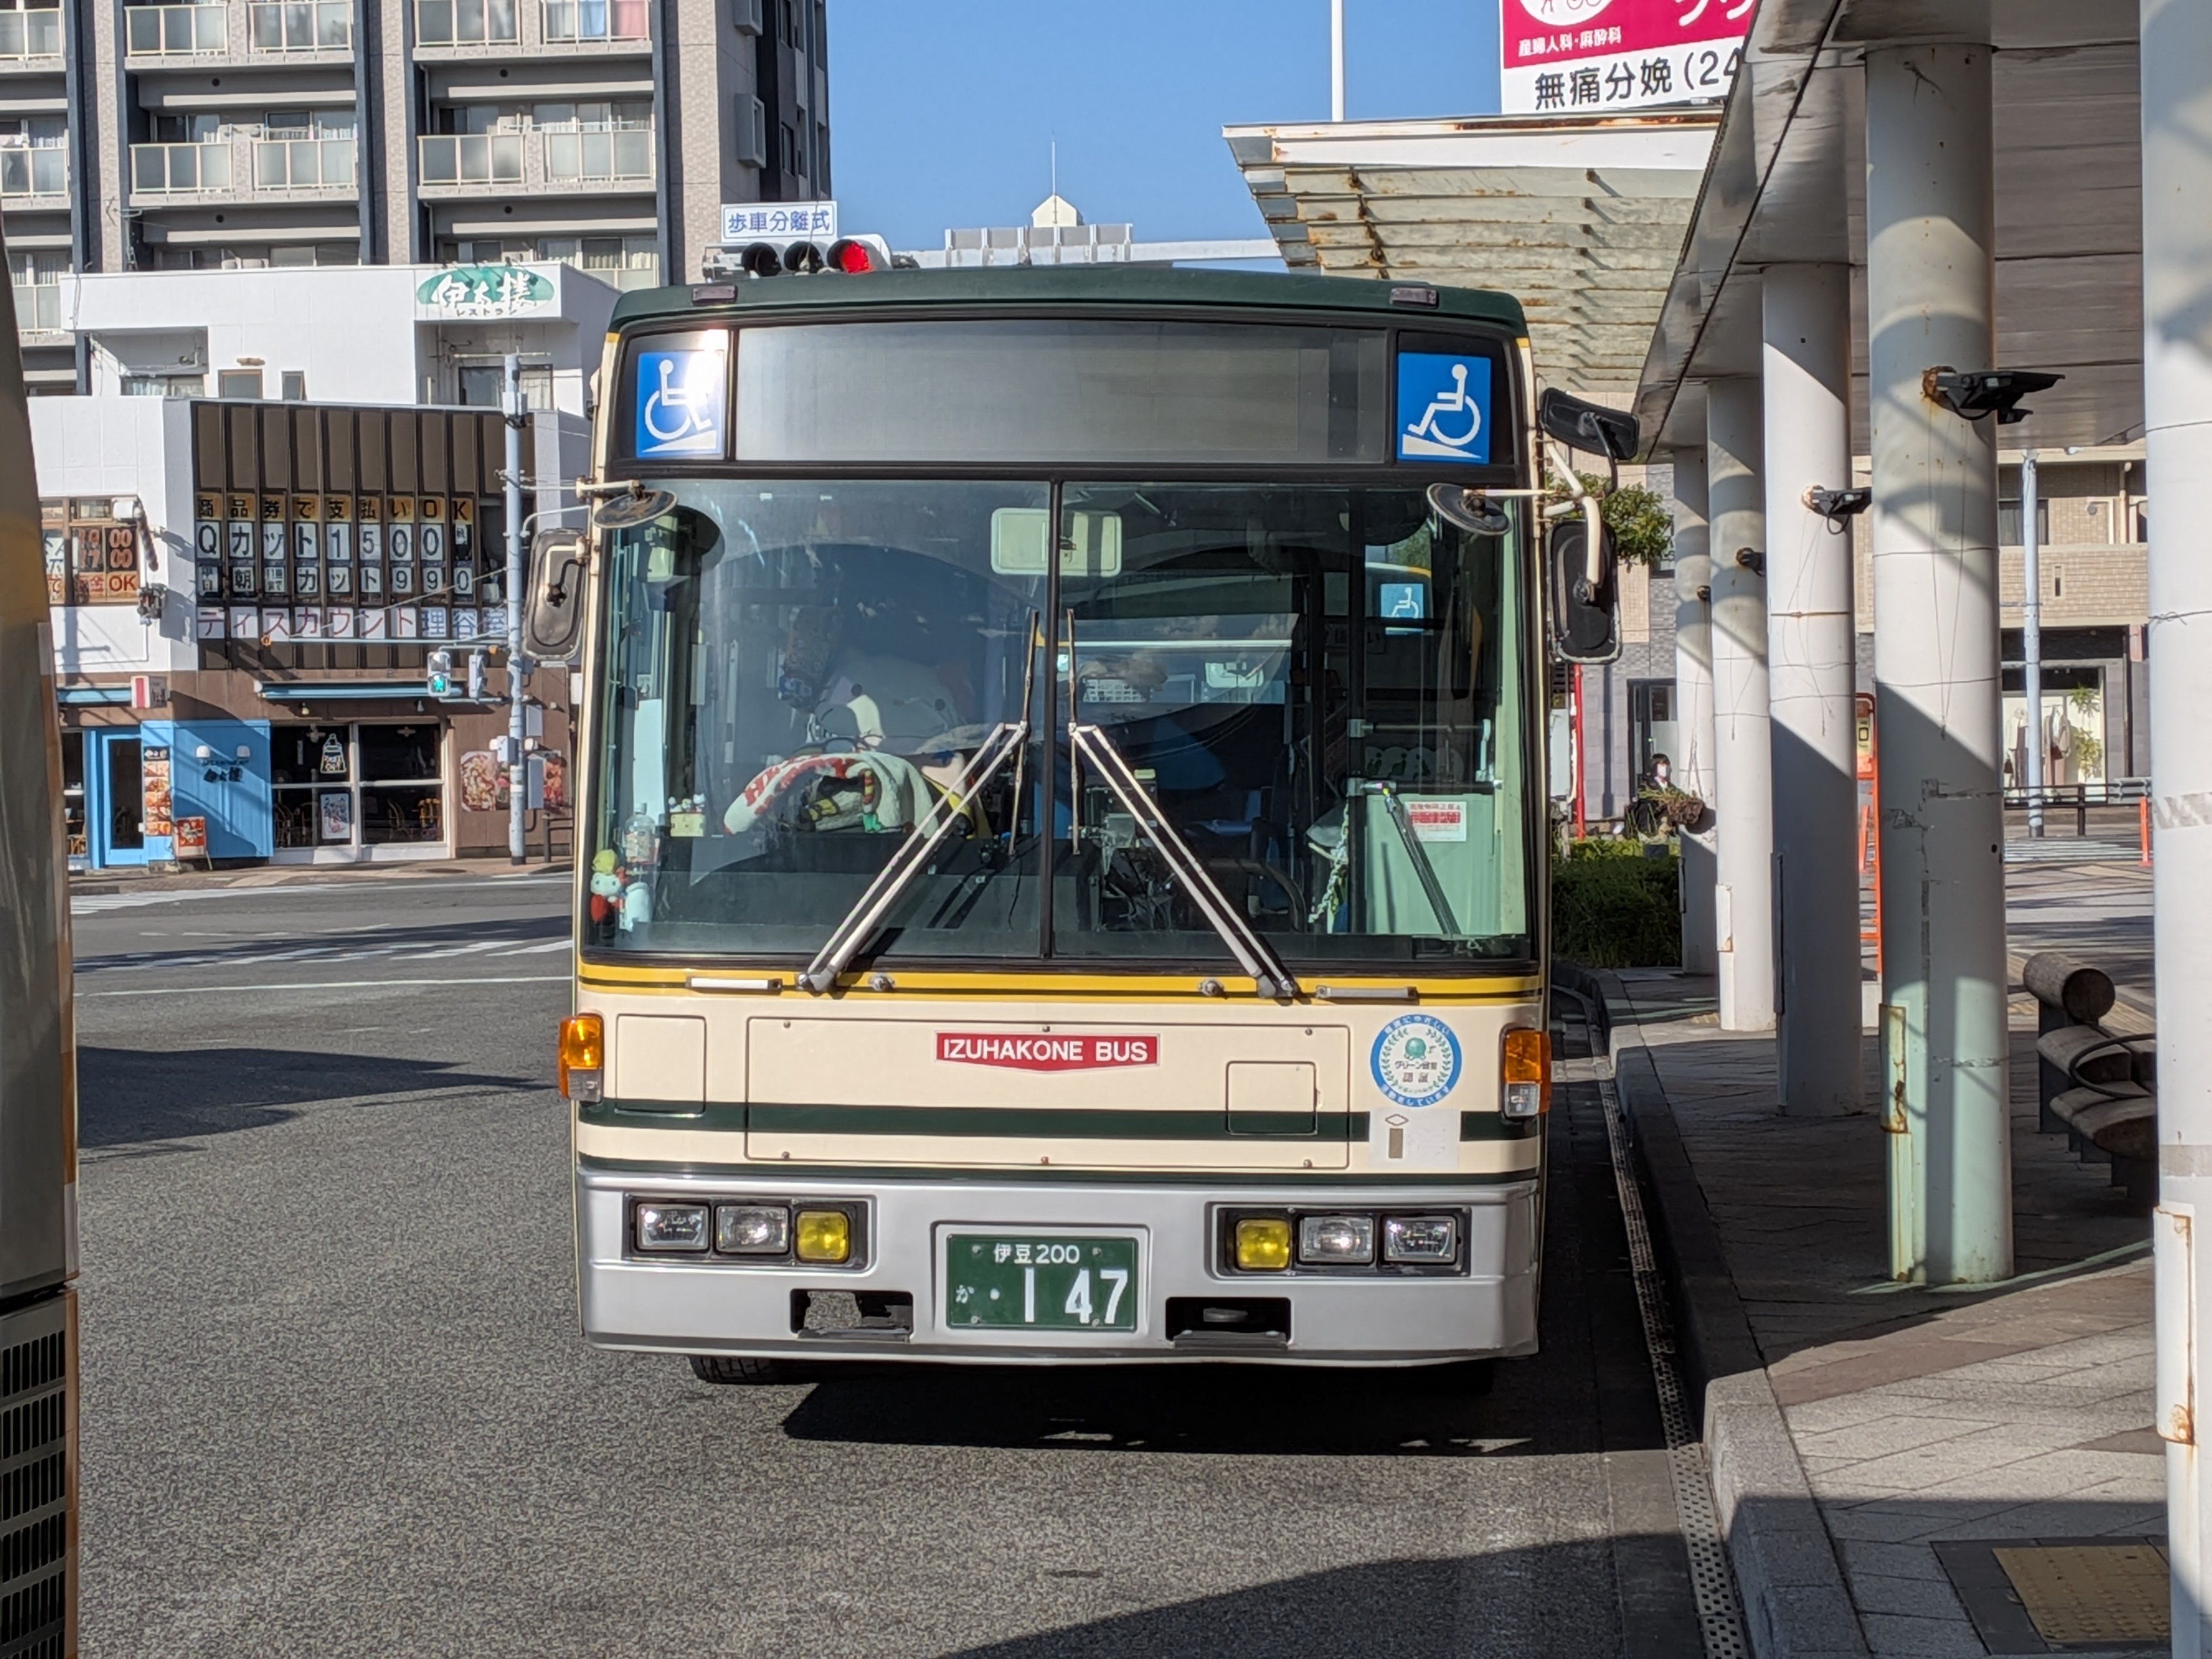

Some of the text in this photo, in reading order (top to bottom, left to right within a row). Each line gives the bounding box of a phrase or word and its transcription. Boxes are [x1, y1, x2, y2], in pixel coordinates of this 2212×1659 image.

[1535, 56, 1672, 110] 無痛分娩
[728, 210, 830, 233] 歩車分離式
[943, 1039, 1148, 1062] IZUHAKONE BUS
[994, 1243, 1080, 1264] 伊豆200
